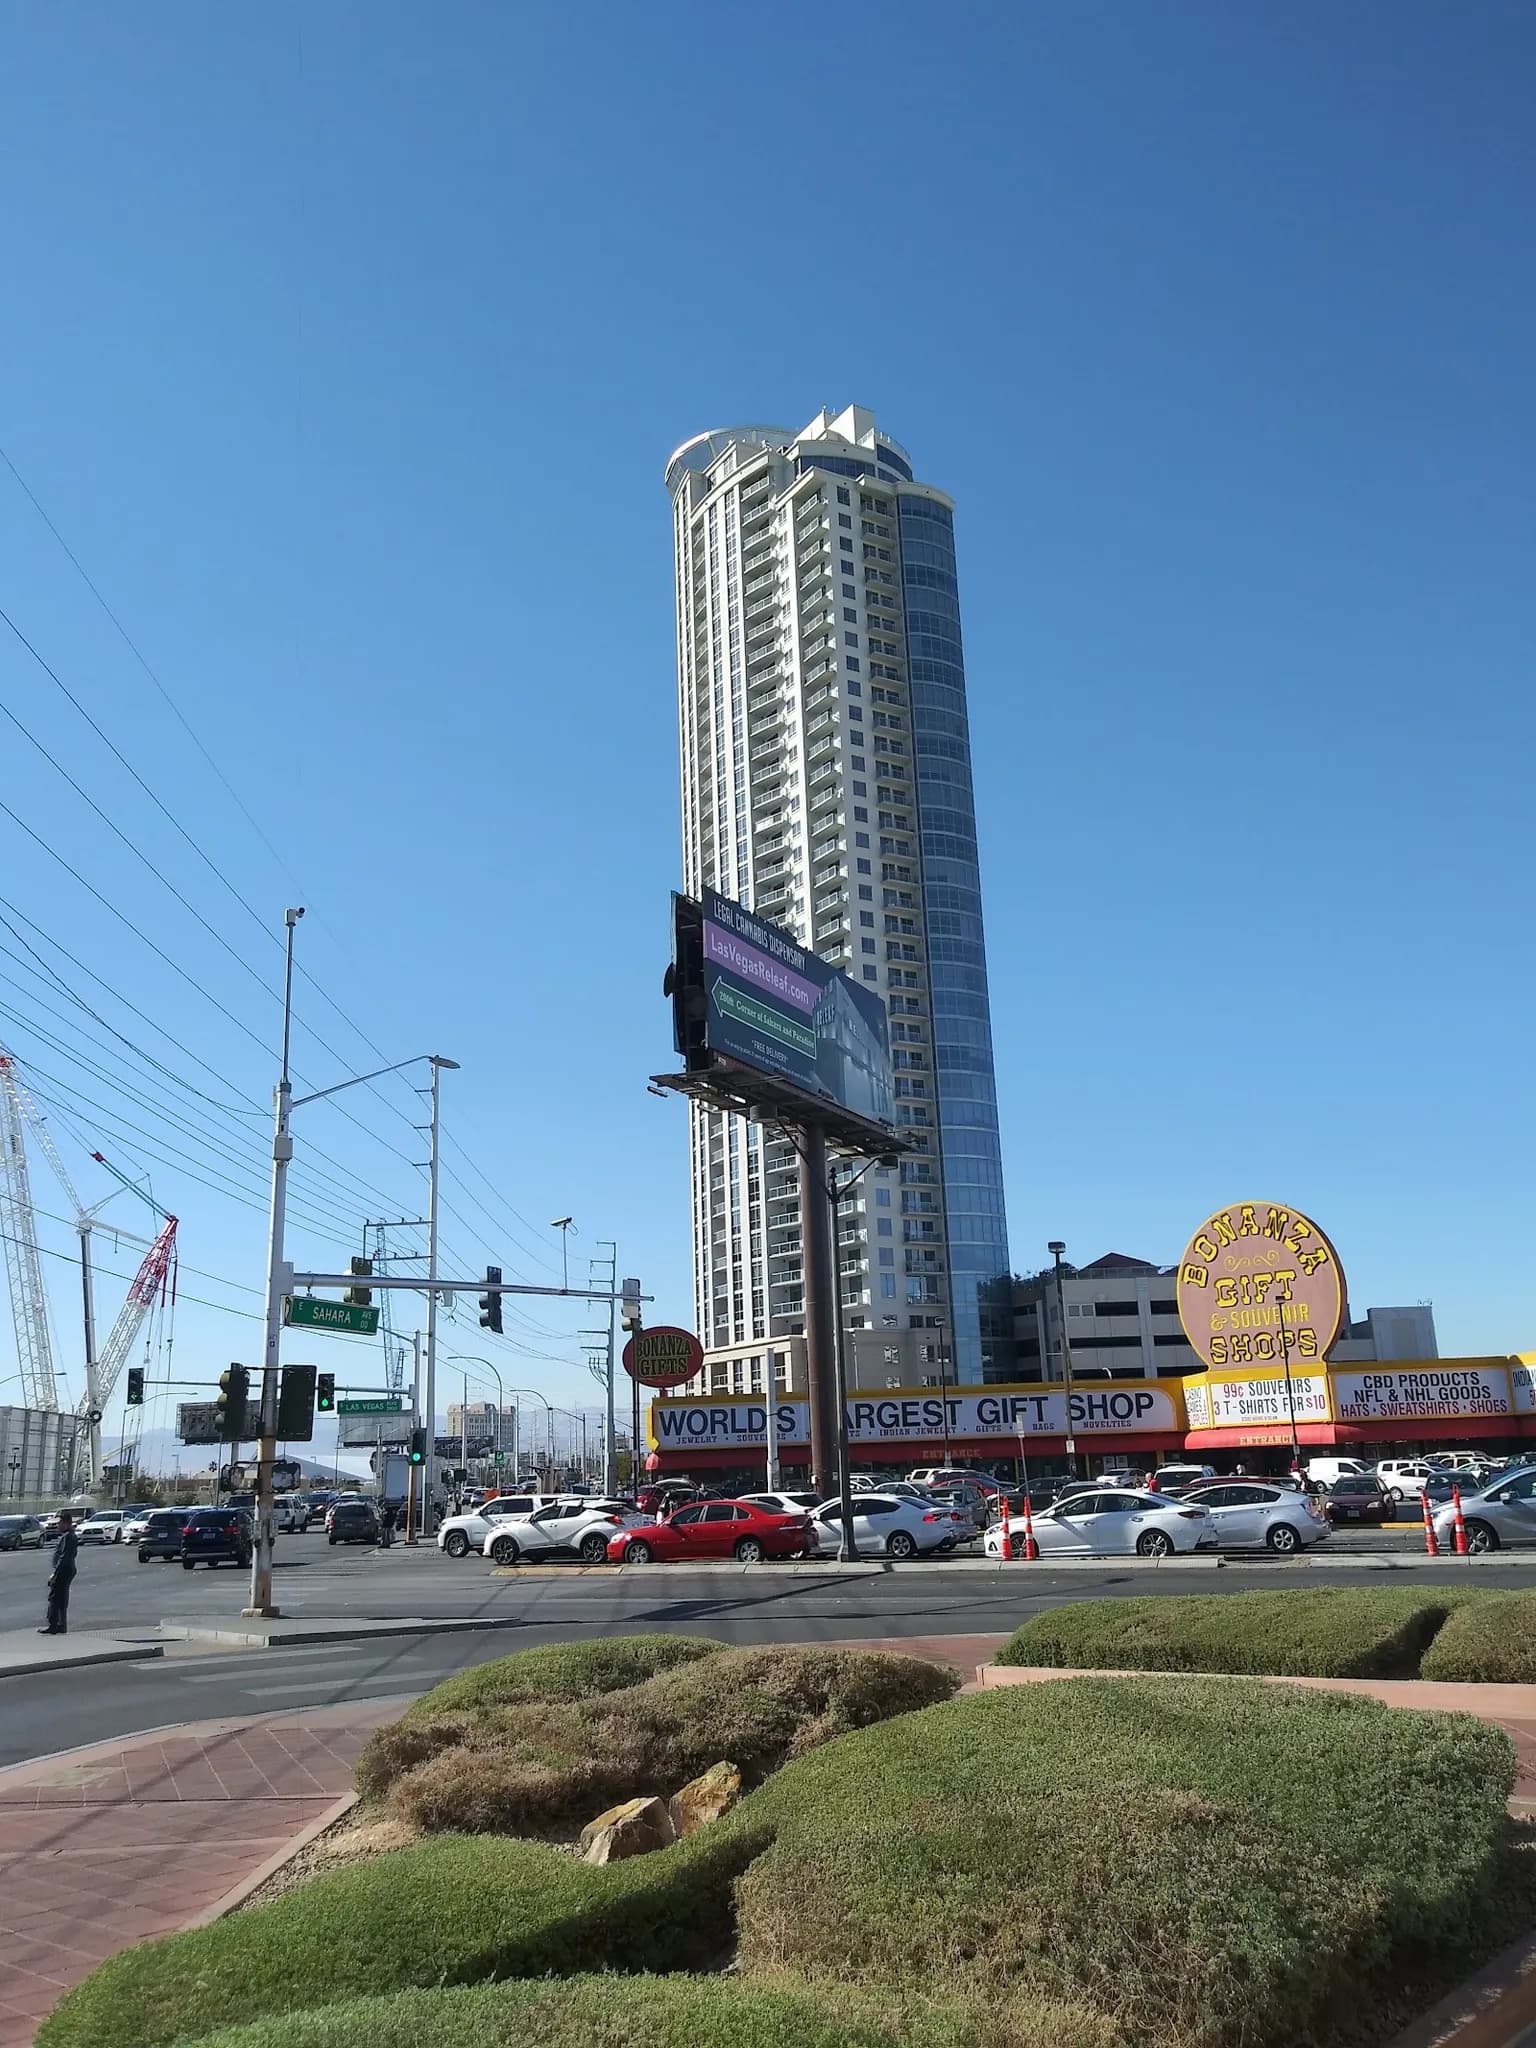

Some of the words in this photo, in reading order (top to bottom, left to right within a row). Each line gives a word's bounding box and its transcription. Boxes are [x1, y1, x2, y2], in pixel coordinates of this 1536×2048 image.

[713, 899, 735, 928] LEGAL
[736, 913, 768, 948] CANNABIS
[769, 934, 806, 971] DISPENSARY
[711, 932, 809, 1004] LasVegasReleaf.com
[1182, 1206, 1329, 1288] BONANZA
[1214, 1269, 1296, 1308] GIFT
[299, 1301, 304, 1311] E
[312, 1307, 351, 1324] SAHARA
[361, 1311, 373, 1320] AVE
[1210, 1312, 1227, 1331] &
[1230, 1303, 1311, 1329] SOUVENIR
[637, 1333, 693, 1357] BONANZA
[1210, 1328, 1317, 1364] SHOPS
[640, 1357, 689, 1376] GIFTS
[1248, 1378, 1312, 1397] SOUVENIRS
[1363, 1375, 1393, 1389] CBD
[1399, 1371, 1480, 1388] PRODUCTS
[1354, 1389, 1383, 1403] NFL
[1388, 1388, 1399, 1402] &
[1404, 1387, 1435, 1402] NHL
[1438, 1385, 1492, 1400] GOODS
[345, 1403, 360, 1411] LAS
[362, 1402, 385, 1410] VEGAS
[977, 1397, 1049, 1425] GIFT
[1069, 1392, 1154, 1421] SHOP
[1214, 1401, 1221, 1416] 3
[1283, 1396, 1305, 1413] FOR
[1341, 1403, 1370, 1418] HATS
[1380, 1400, 1460, 1417] SWEATSHIRTS
[1470, 1399, 1508, 1414] SHOES
[676, 1436, 718, 1445] JEWELRY
[880, 1428, 911, 1437] INDIAN
[976, 1424, 1002, 1433] GIFTS
[1033, 1423, 1055, 1431] BAGS
[1083, 1419, 1132, 1429] NOVELTIES
[922, 1449, 982, 1460] ENTANCE
